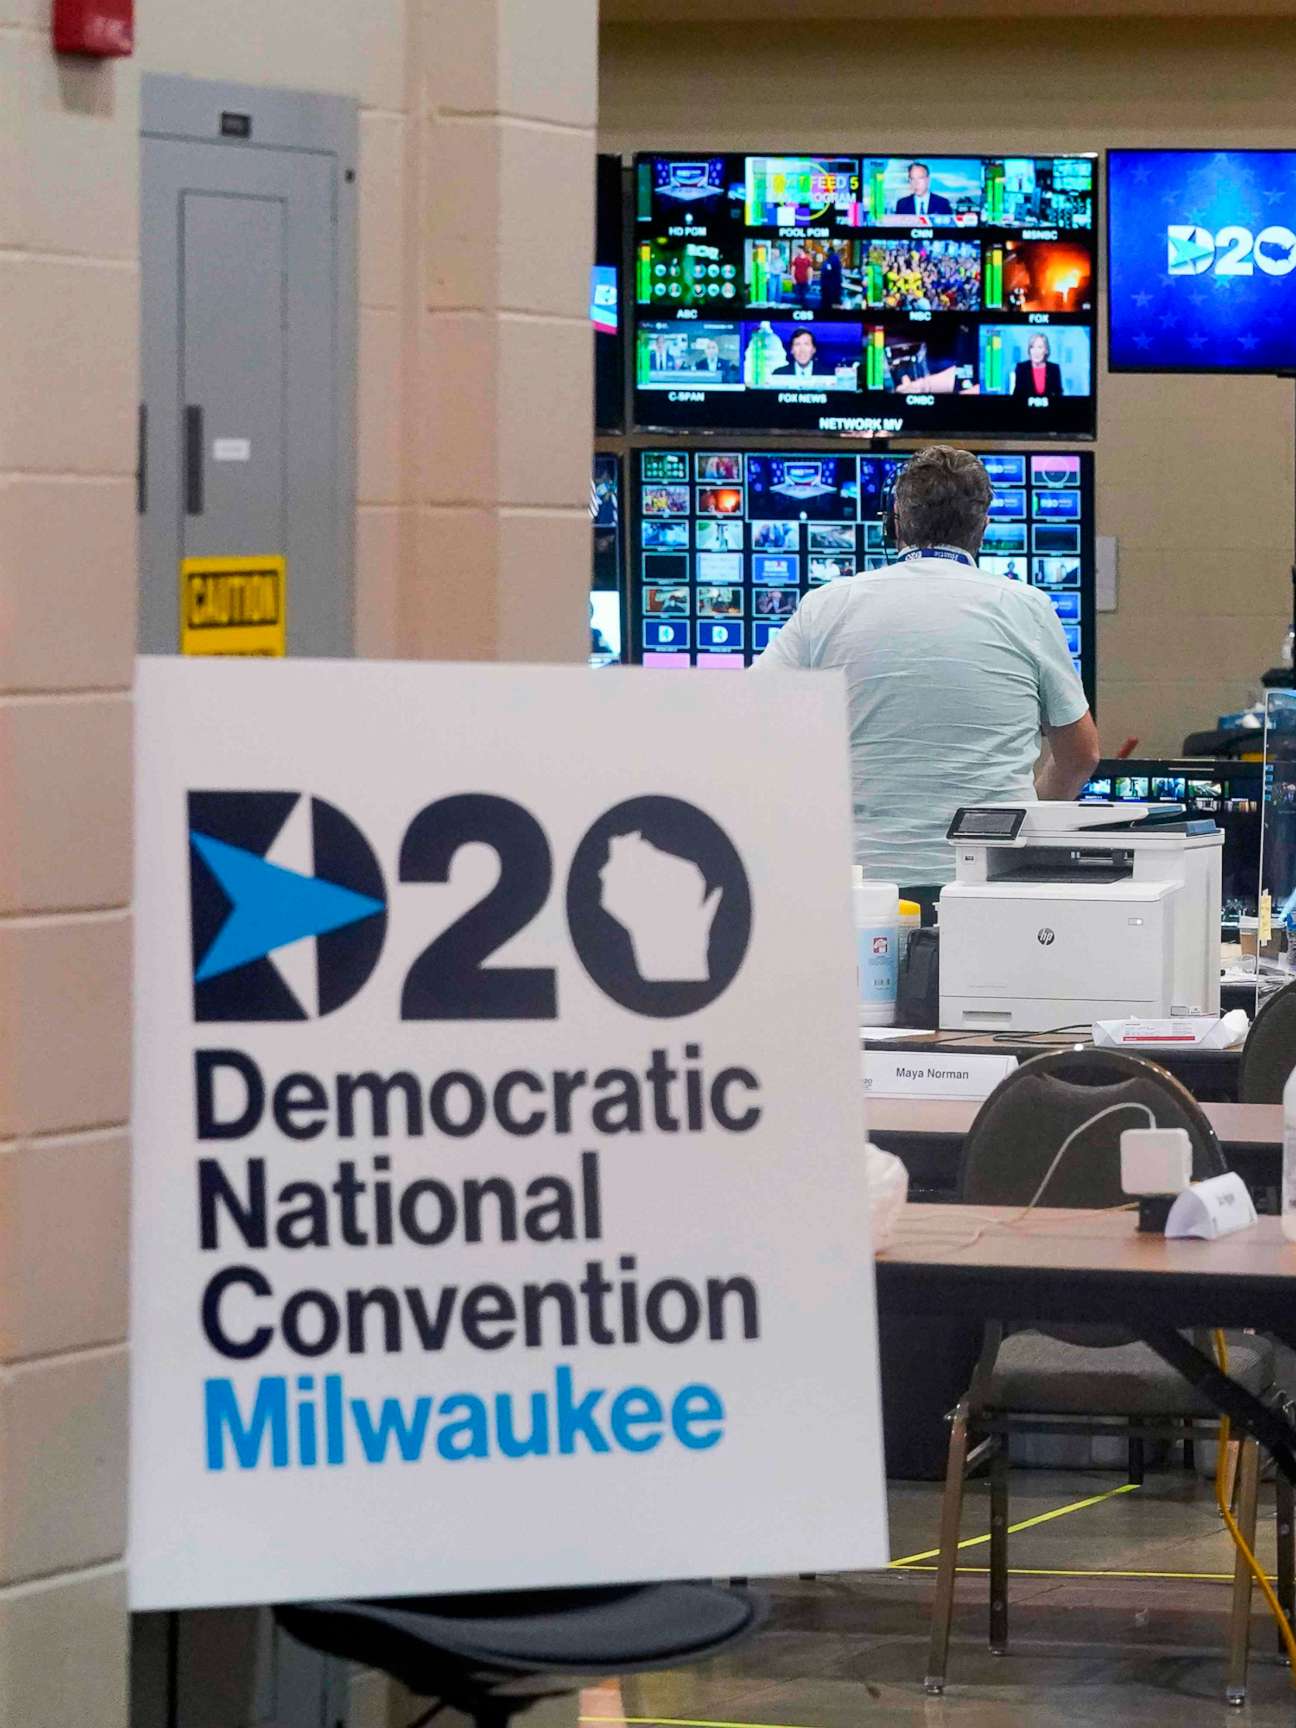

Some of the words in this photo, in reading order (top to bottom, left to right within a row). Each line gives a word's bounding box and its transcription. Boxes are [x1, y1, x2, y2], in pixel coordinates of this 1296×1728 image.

[850, 176, 859, 188] 5
[779, 228, 806, 238] POOL
[807, 228, 830, 238] PGM
[911, 228, 934, 239] CNN
[1022, 230, 1059, 240] MSNBC
[676, 309, 698, 319] ABC
[792, 310, 814, 320] CBS
[909, 312, 932, 322] NBC
[1029, 313, 1049, 323] FOX
[668, 391, 706, 402] C-SPAN
[778, 393, 799, 403] FOX
[799, 393, 828, 404] NEWS
[906, 395, 935, 406] CNBC
[1028, 396, 1049, 407] PBS
[819, 417, 881, 430] NETWORK
[882, 418, 904, 431] MV
[186, 788, 752, 1024] D20
[896, 1067, 924, 1081] Maya
[927, 1068, 970, 1080] Norman
[193, 1044, 763, 1142] Democratic
[196, 1150, 604, 1252] National
[201, 1255, 761, 1361] Convention
[202, 1364, 728, 1473] Milwaukee
